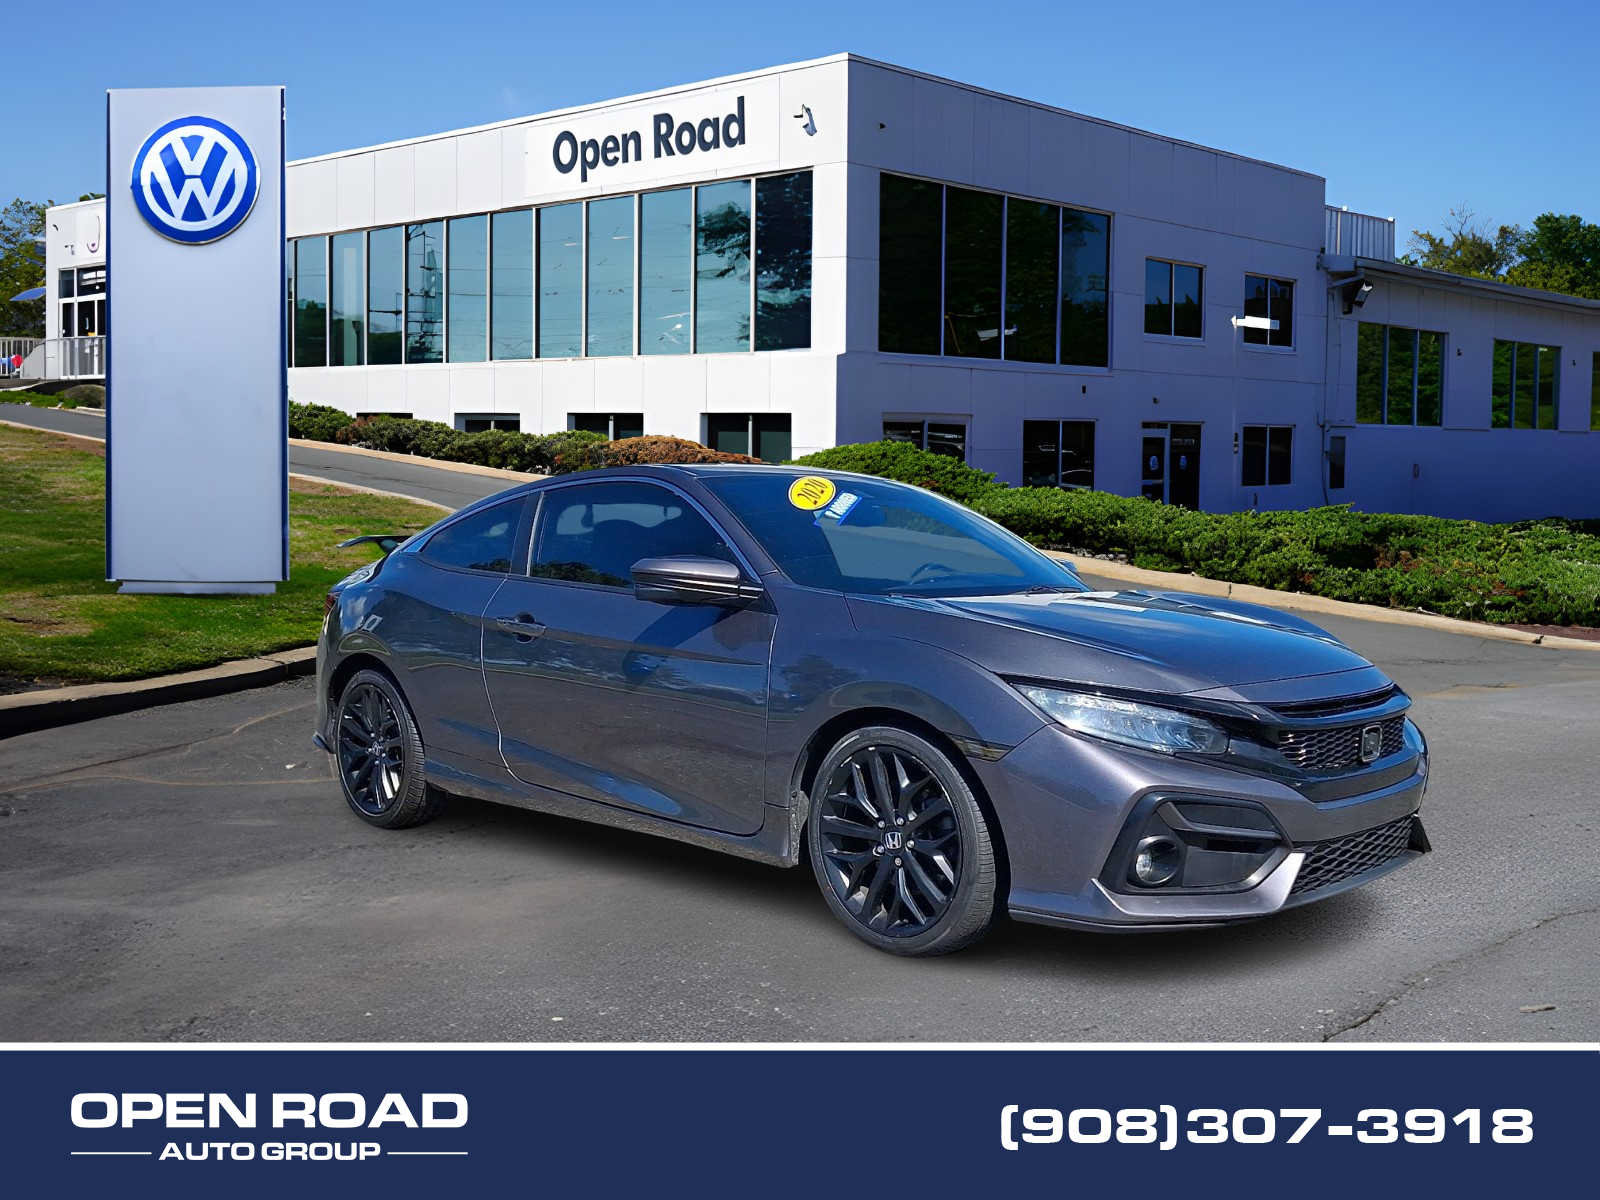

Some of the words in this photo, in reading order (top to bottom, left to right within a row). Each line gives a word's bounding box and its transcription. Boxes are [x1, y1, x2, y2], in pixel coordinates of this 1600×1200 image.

[553, 130, 642, 183] Open
[653, 95, 746, 159] Road
[797, 479, 827, 505] 2020
